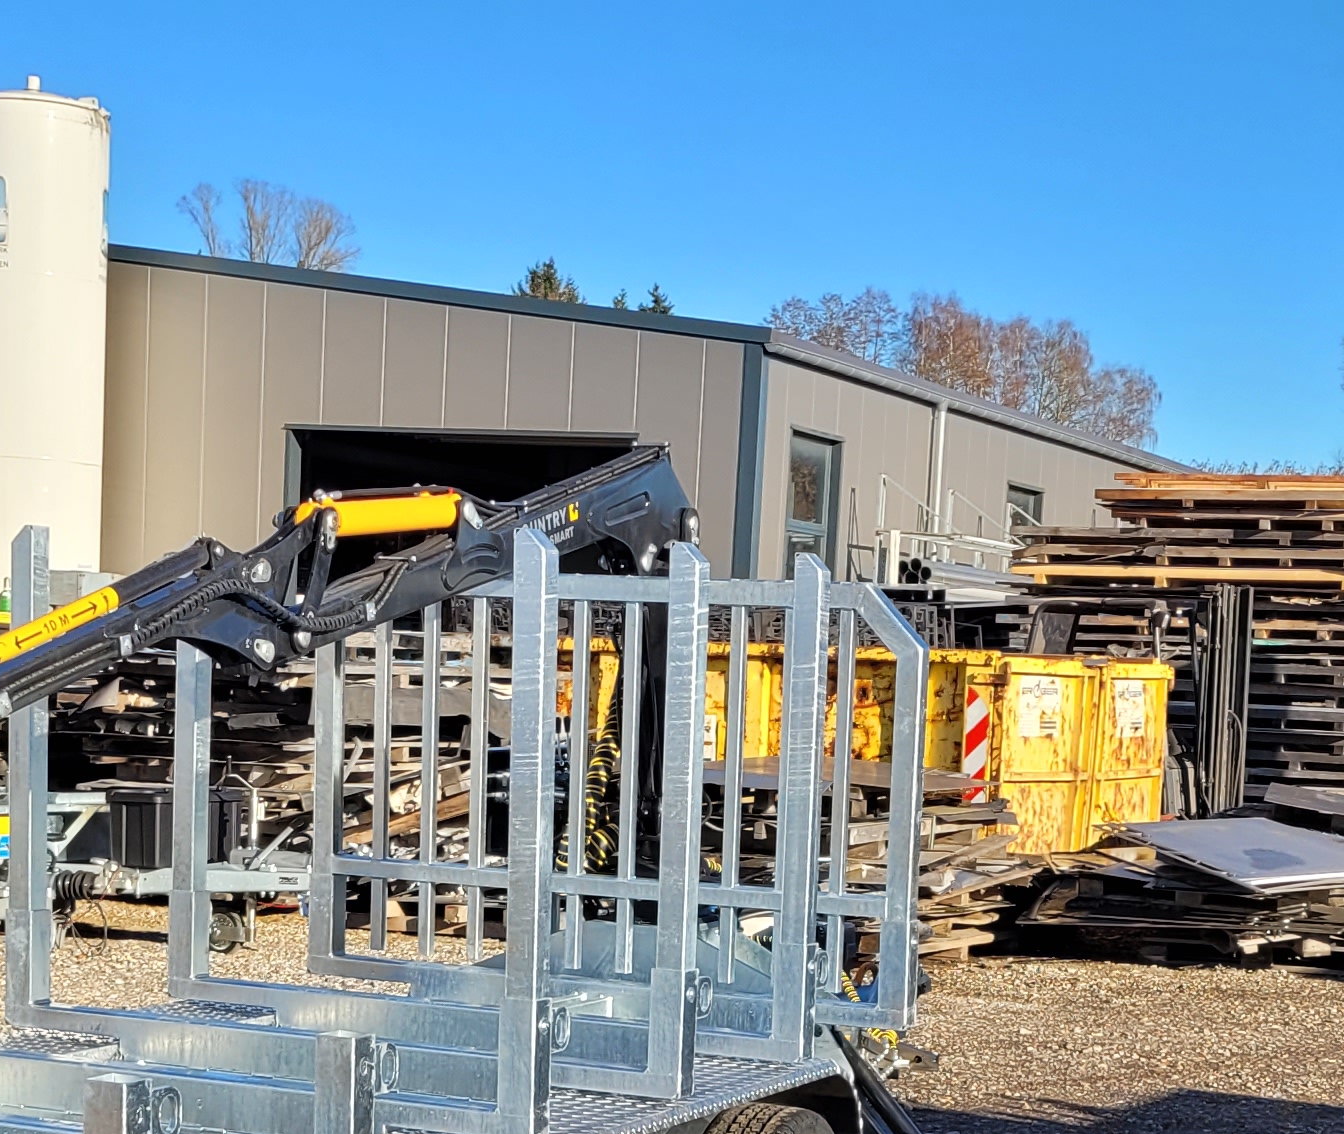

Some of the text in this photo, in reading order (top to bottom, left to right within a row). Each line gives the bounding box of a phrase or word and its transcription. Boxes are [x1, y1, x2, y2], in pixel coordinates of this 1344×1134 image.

[522, 507, 567, 532] UNTRY
[549, 526, 575, 545] SMART
[60, 613, 70, 627] M
